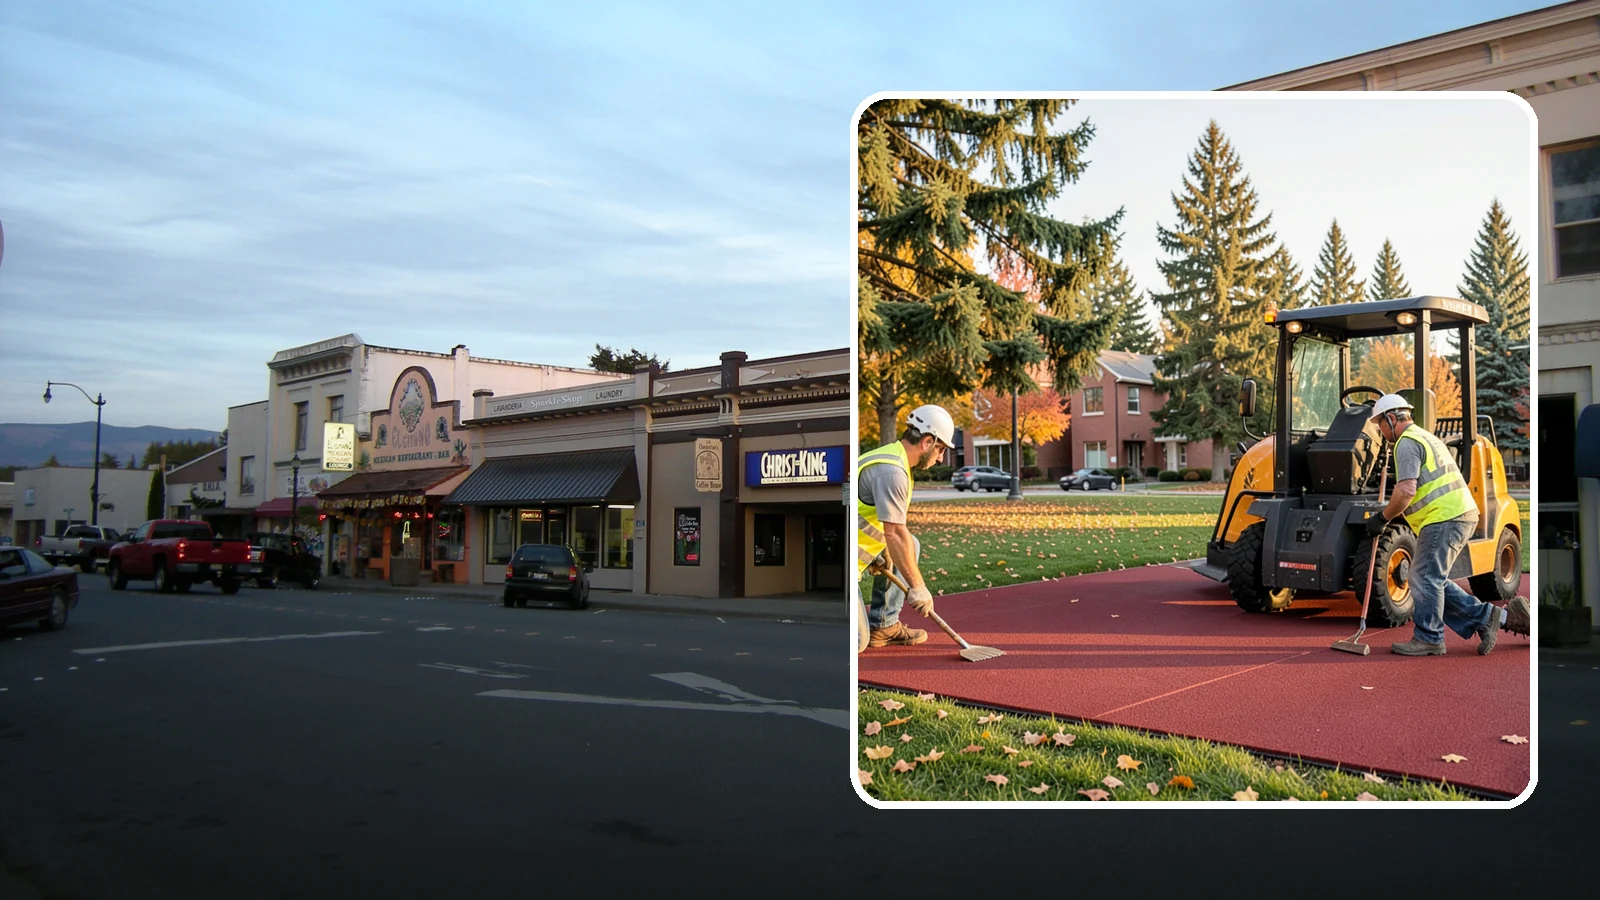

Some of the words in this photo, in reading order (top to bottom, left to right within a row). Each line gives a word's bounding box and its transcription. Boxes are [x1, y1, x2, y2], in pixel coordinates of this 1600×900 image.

[531, 396, 561, 408] Sparkle
[562, 394, 582, 406] Shop
[596, 389, 623, 400] LAUNDRY
[494, 402, 522, 412] LAVANDERIA
[374, 455, 396, 464] MEXICAN
[398, 452, 433, 462] RESTAURANT
[438, 450, 450, 458] BAR
[761, 452, 797, 478] CHRIST
[799, 450, 828, 476] KING
